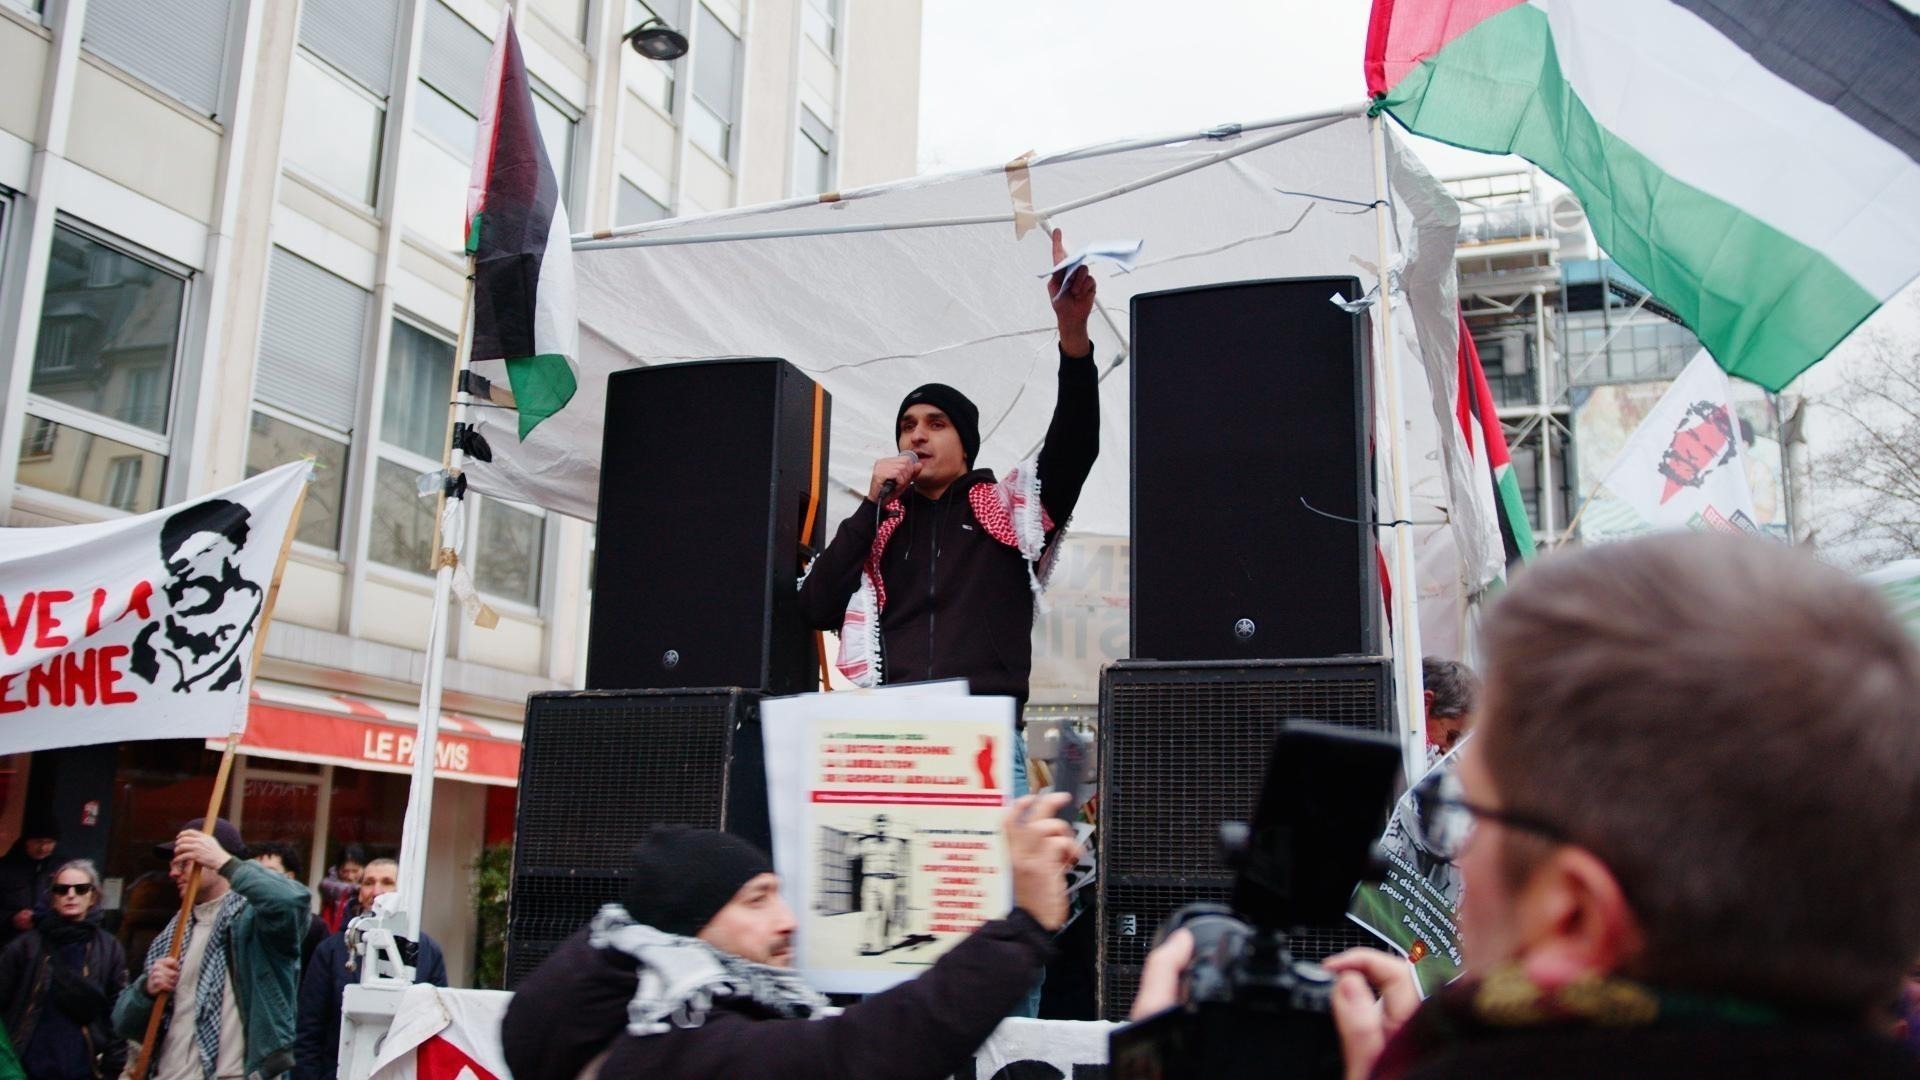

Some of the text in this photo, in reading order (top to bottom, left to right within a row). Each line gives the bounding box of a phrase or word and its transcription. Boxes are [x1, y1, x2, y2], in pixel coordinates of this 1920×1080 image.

[363, 729, 469, 771] LE PVIS
[1400, 878, 1457, 935] détournement
[1421, 877, 1450, 908] femme
[1379, 882, 1405, 902] pour
[1405, 898, 1414, 911] la
[1415, 906, 1451, 949] libération
[1403, 914, 1438, 953] Palestine
